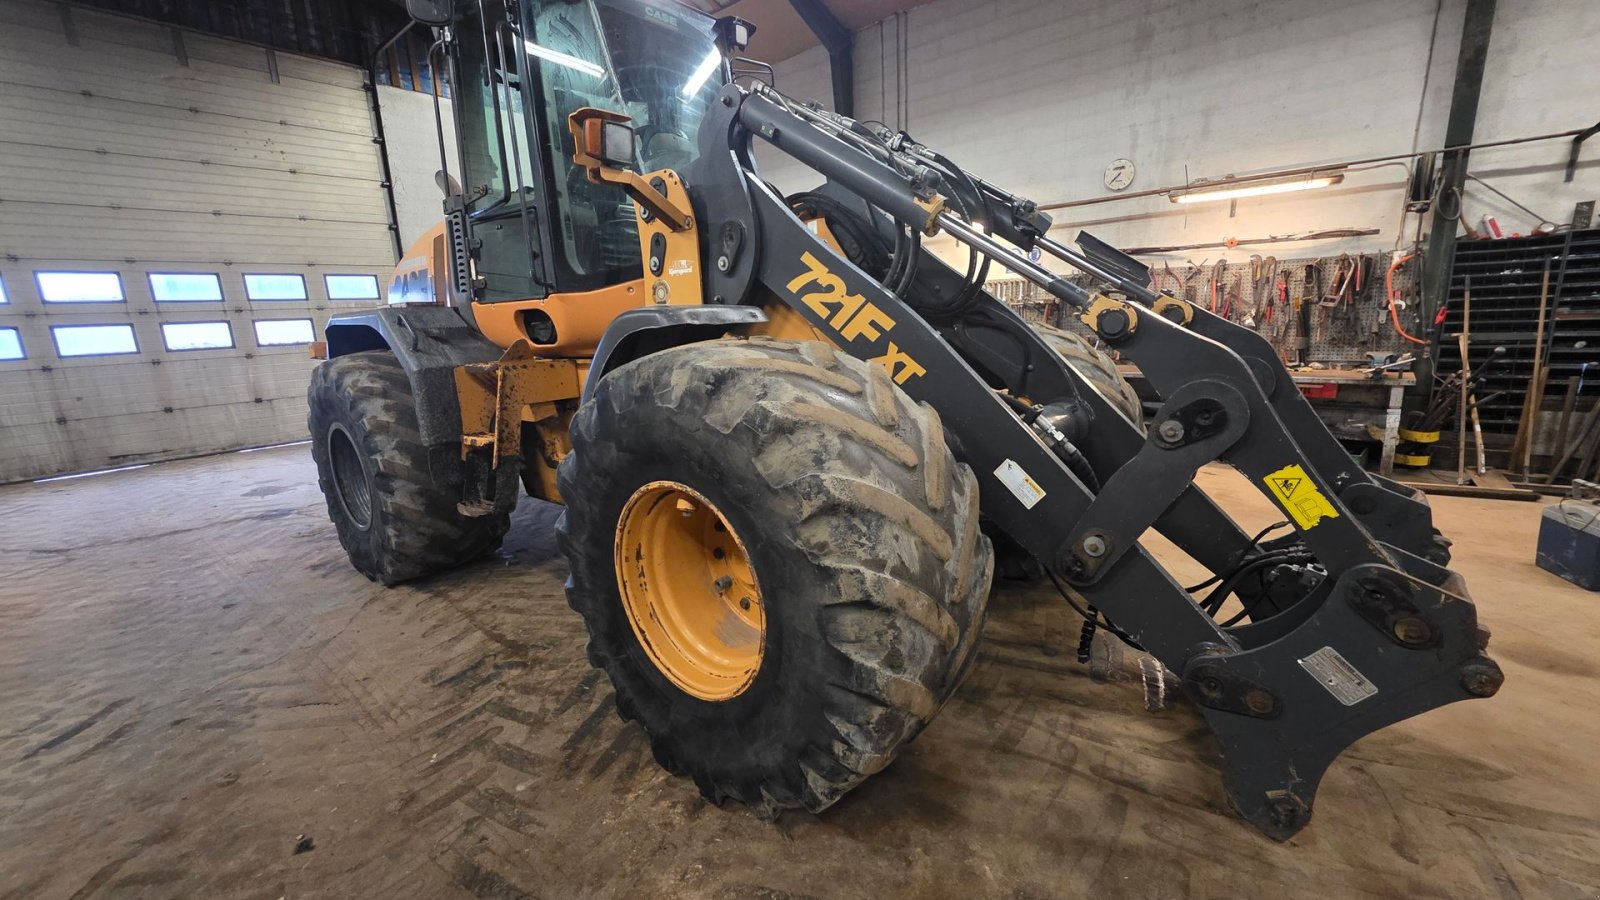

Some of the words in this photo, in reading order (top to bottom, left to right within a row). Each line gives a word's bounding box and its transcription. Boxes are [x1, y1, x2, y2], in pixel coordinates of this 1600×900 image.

[645, 7, 678, 27] CASE
[786, 251, 896, 342] 721F
[868, 341, 927, 385] XT
